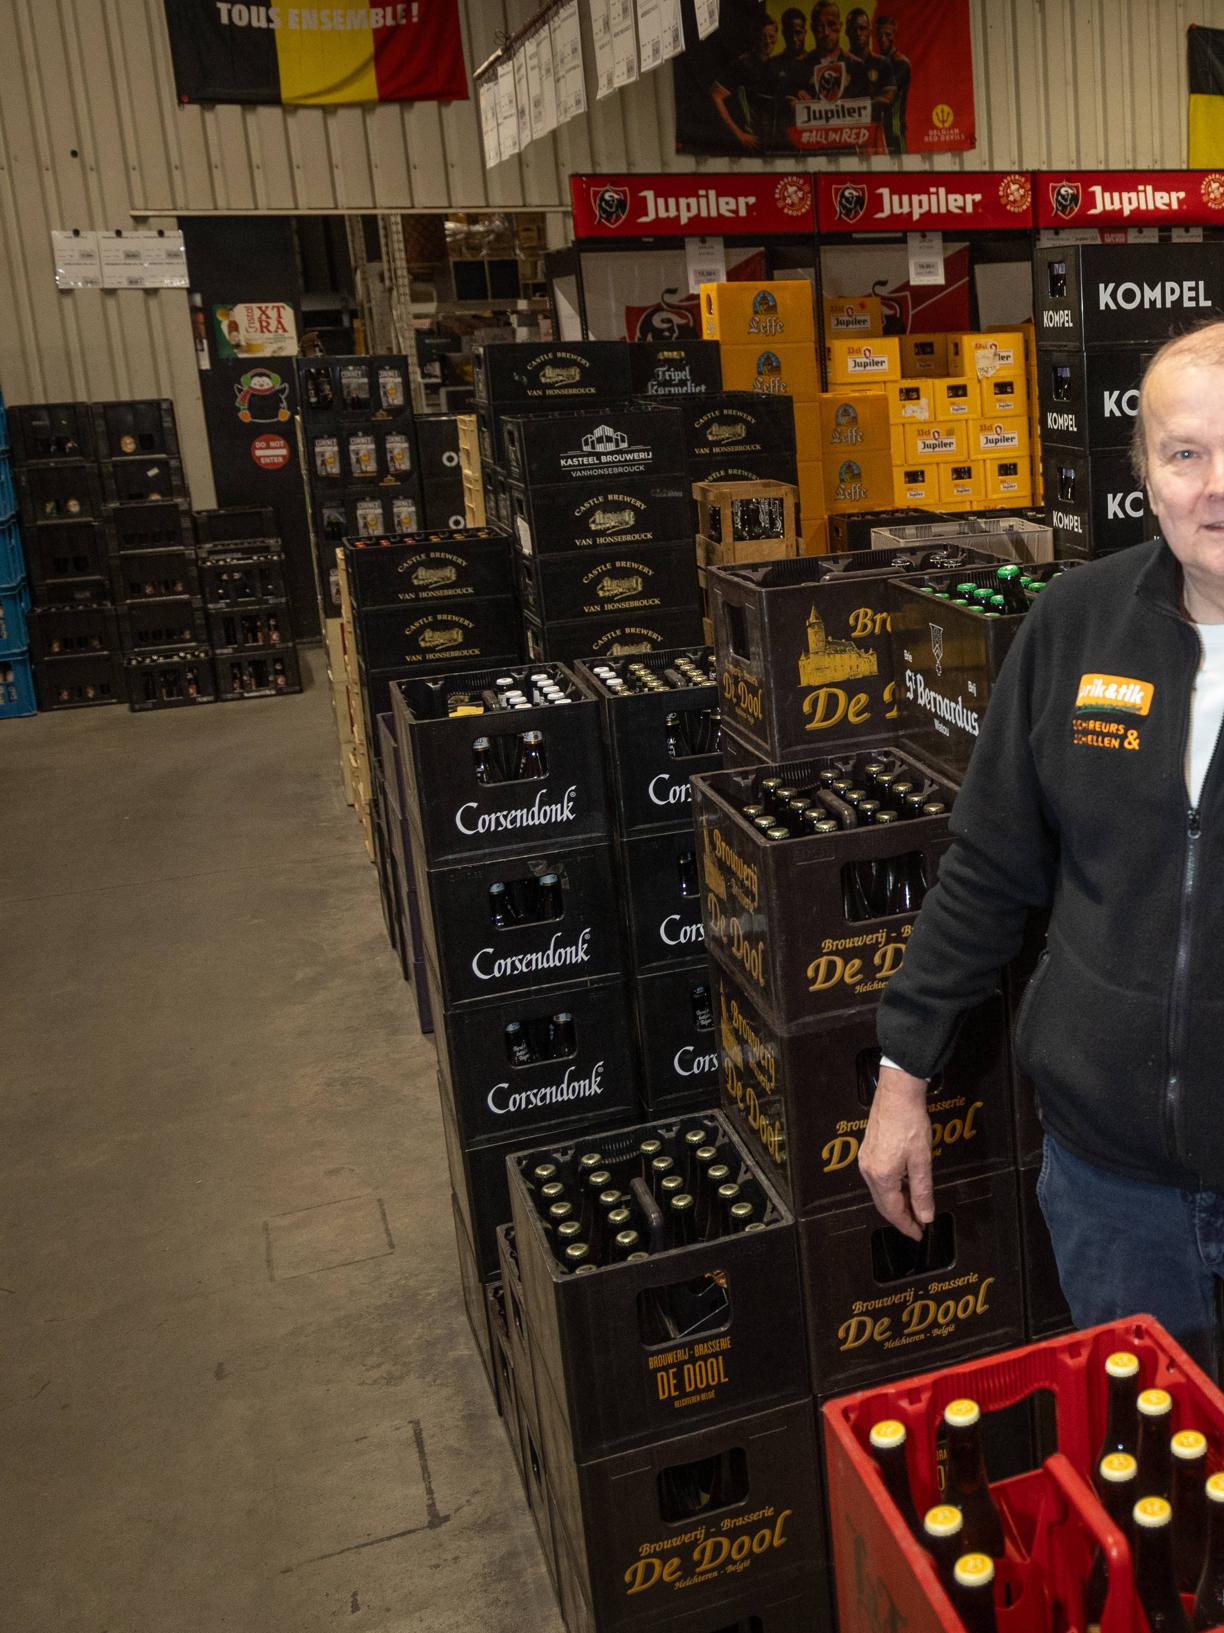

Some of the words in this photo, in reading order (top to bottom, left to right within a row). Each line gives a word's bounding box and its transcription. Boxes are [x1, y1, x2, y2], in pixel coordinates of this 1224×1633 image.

[216, 3, 279, 29] TOUS
[803, 103, 867, 123] Jupiler
[637, 189, 757, 225] Jupiler
[872, 187, 983, 222] Jupiler
[1087, 185, 1186, 217] Jupiler
[1099, 281, 1213, 310] KOMPEL
[748, 315, 784, 337] Leffe
[834, 317, 868, 328] Jupiler
[1043, 310, 1073, 328] KOMPEL
[527, 351, 553, 370] CASTLE
[556, 351, 590, 368] BREWERY
[851, 359, 886, 370] Jupiler
[654, 366, 691, 381] Tripel
[527, 388, 542, 397] VAN
[1047, 412, 1077, 432] KOMPEL
[255, 441, 267, 449] DO
[269, 440, 284, 448] NOT
[831, 427, 864, 446] Leffe
[921, 441, 955, 452] Jupiler
[984, 435, 1016, 446] Jupiler
[260, 456, 284, 464] ENTER
[560, 455, 599, 467] KASTEEL
[601, 452, 653, 464] BROUWERIJ
[571, 464, 646, 478] VANHONSEBROUCK
[703, 469, 725, 483] ASTLE
[834, 483, 868, 502] Leffe
[574, 495, 604, 517] CASTLE
[607, 494, 647, 511] BREWERY
[1052, 510, 1083, 534] KOMPEL
[575, 538, 592, 546] VAN
[596, 531, 653, 544] HONSEBROUCK
[397, 552, 427, 573] CASTLE
[430, 552, 468, 567] BREWERY
[582, 562, 612, 584] CASTLE
[615, 560, 655, 576] BREWERY
[398, 592, 415, 600] VAN
[418, 587, 474, 599] HONSEBROUCK
[583, 604, 601, 613] VAN
[604, 598, 661, 612] HONSEBROUCK
[404, 615, 434, 635] CASTLE
[437, 614, 476, 629] BREWERY
[592, 629, 623, 650] CASTLE
[625, 627, 664, 643] BREWERY
[405, 654, 422, 662] VAN
[425, 648, 480, 661] HONSEBROUCK
[802, 687, 871, 730] De
[916, 673, 979, 737] Bernardus
[455, 785, 577, 835] Corsendonk
[707, 893, 727, 945] De
[730, 917, 766, 988] Dool
[821, 929, 887, 954] Brouwerij
[471, 928, 591, 980] Corsendonk
[806, 953, 863, 993] De
[487, 1061, 604, 1115] Corsendonk
[852, 1287, 915, 1316] Brouwerij
[928, 1272, 979, 1296] Brasserie
[838, 1313, 892, 1352] De
[902, 1277, 995, 1334] Dool
[884, 1333, 925, 1351] Helchteren
[648, 1347, 690, 1370] BROUWERIJ
[694, 1337, 732, 1357] BRASSERIE
[657, 1370, 680, 1401] DE
[684, 1356, 729, 1392] DOOL
[639, 1525, 706, 1557] Brouwerij
[720, 1505, 775, 1532] Brasserie
[623, 1554, 682, 1596] De
[691, 1509, 793, 1571] Dool
